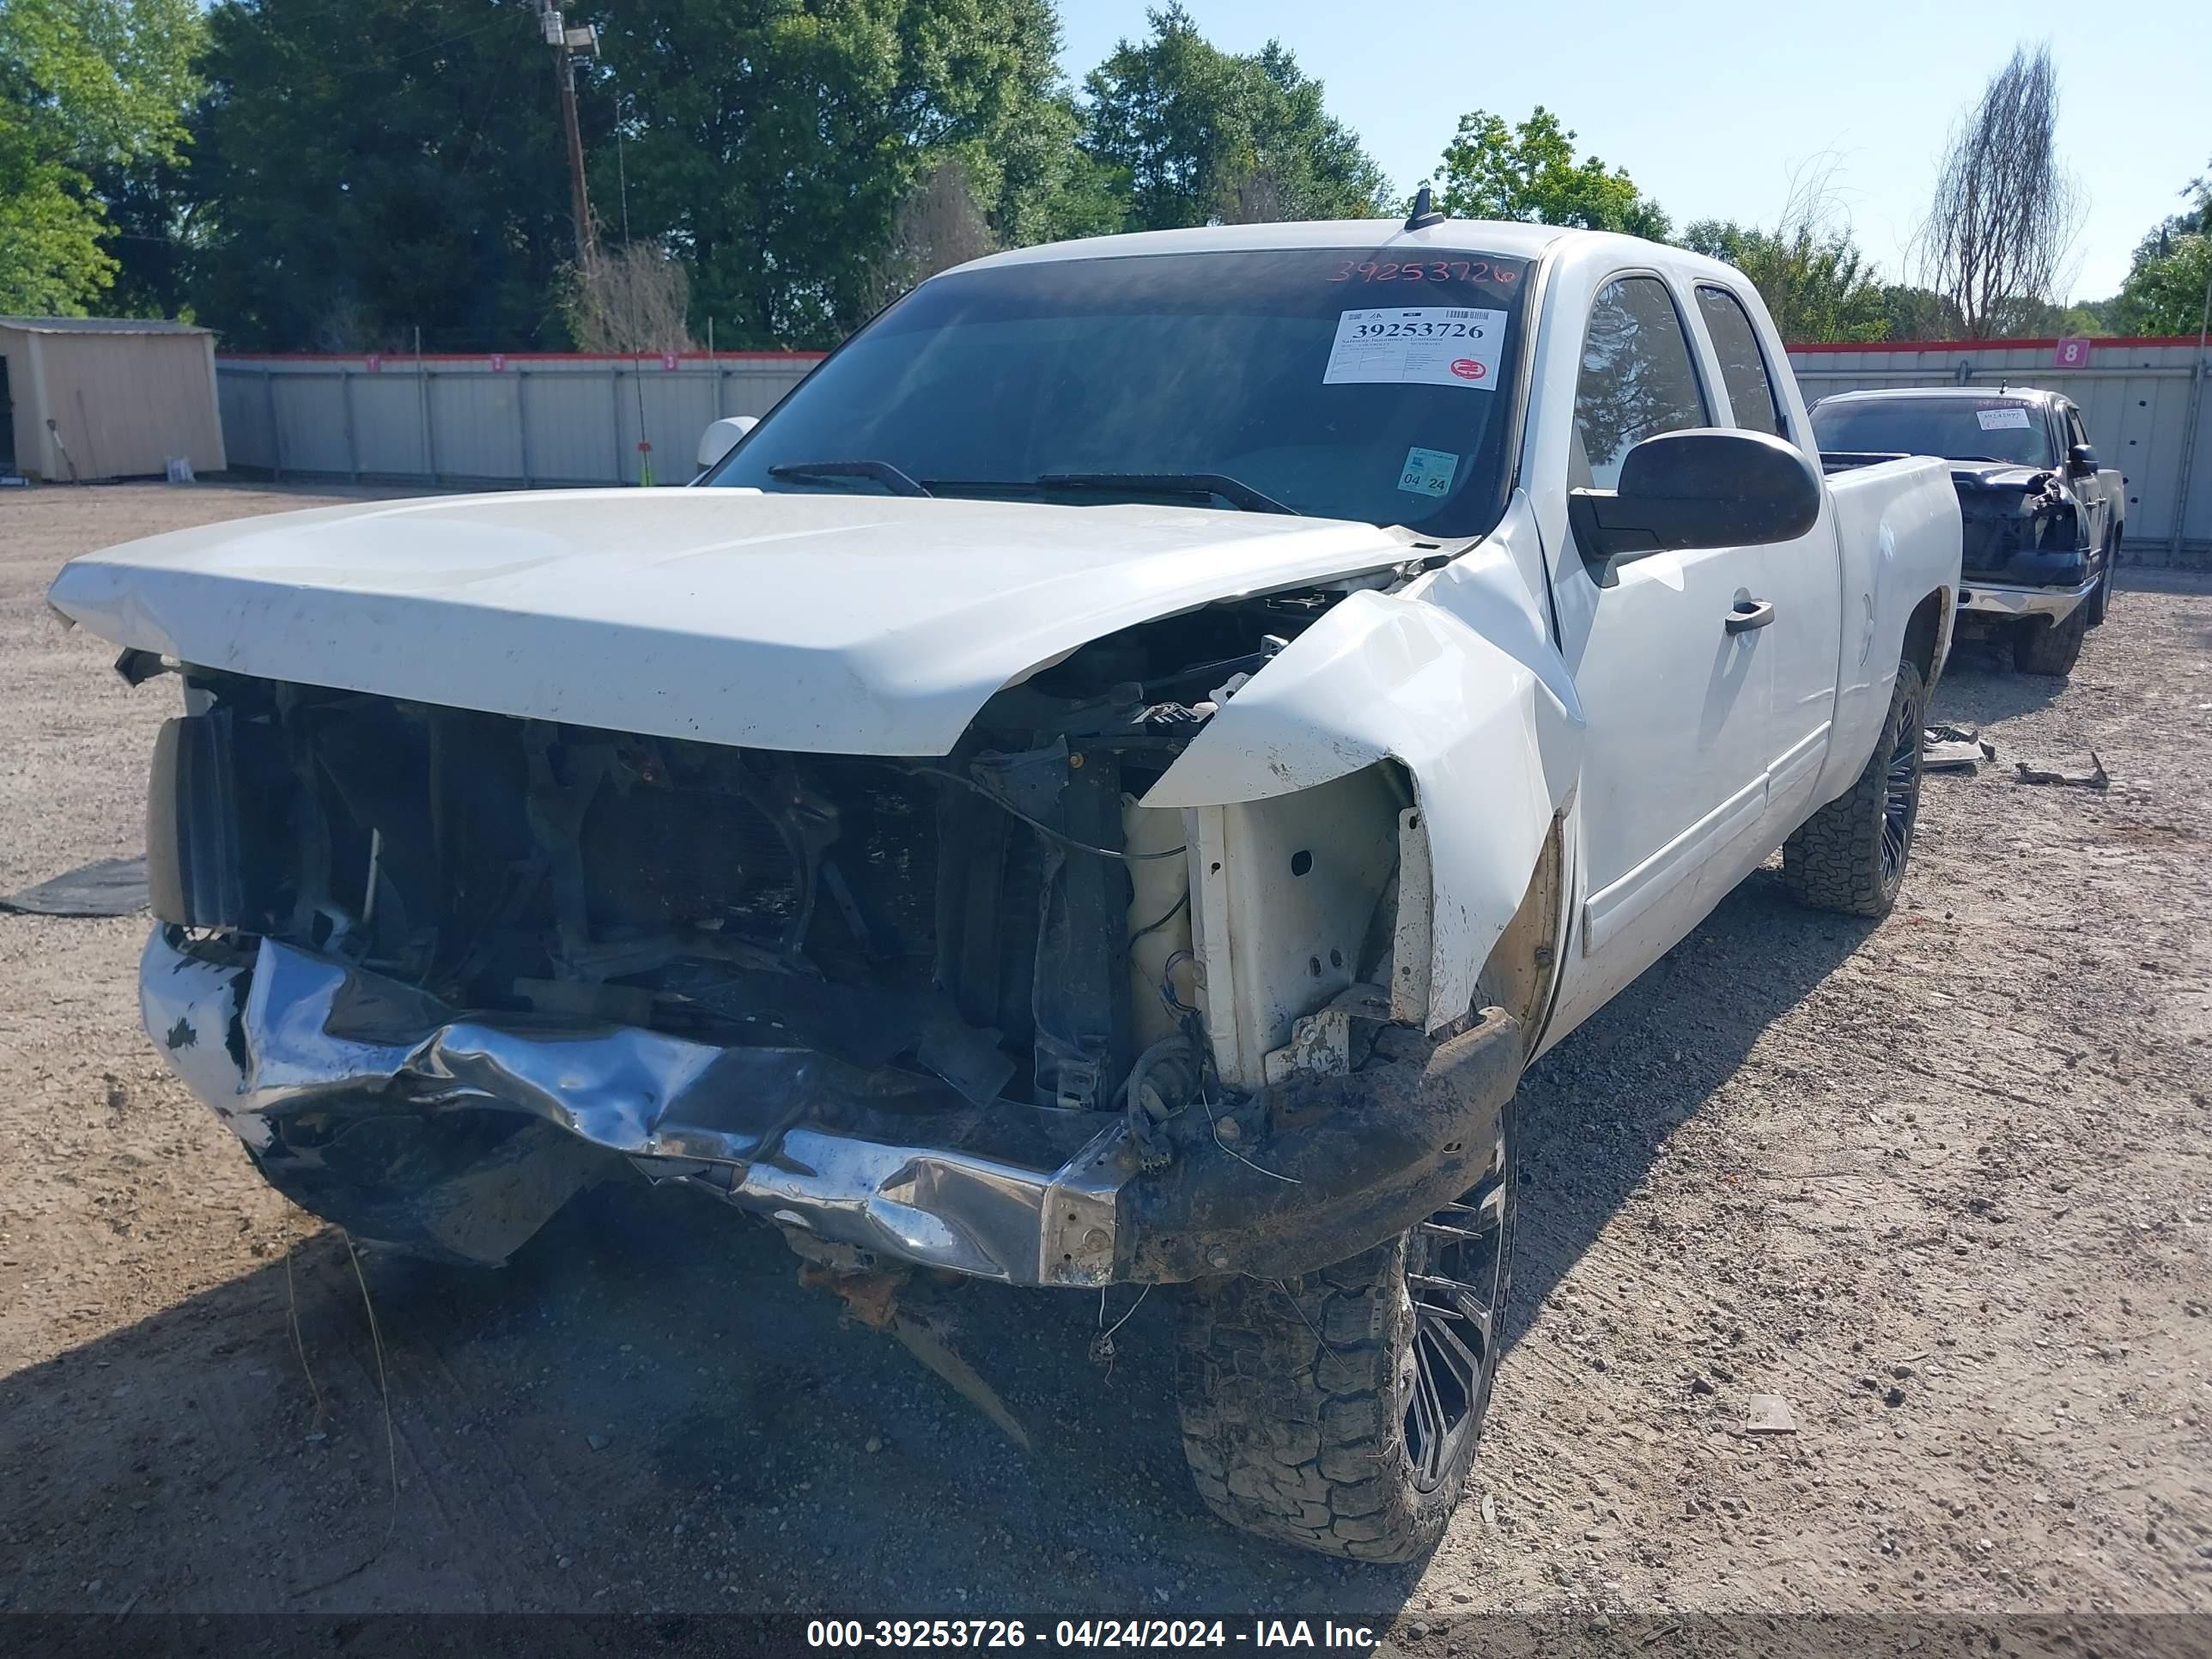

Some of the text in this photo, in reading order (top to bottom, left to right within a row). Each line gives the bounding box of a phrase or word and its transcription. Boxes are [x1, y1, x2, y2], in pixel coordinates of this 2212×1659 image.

[1326, 261, 1516, 283] 39253726
[1352, 323, 1484, 339] 39253726
[2065, 343, 2079, 362] 8
[1404, 473, 1445, 490] 04 24
